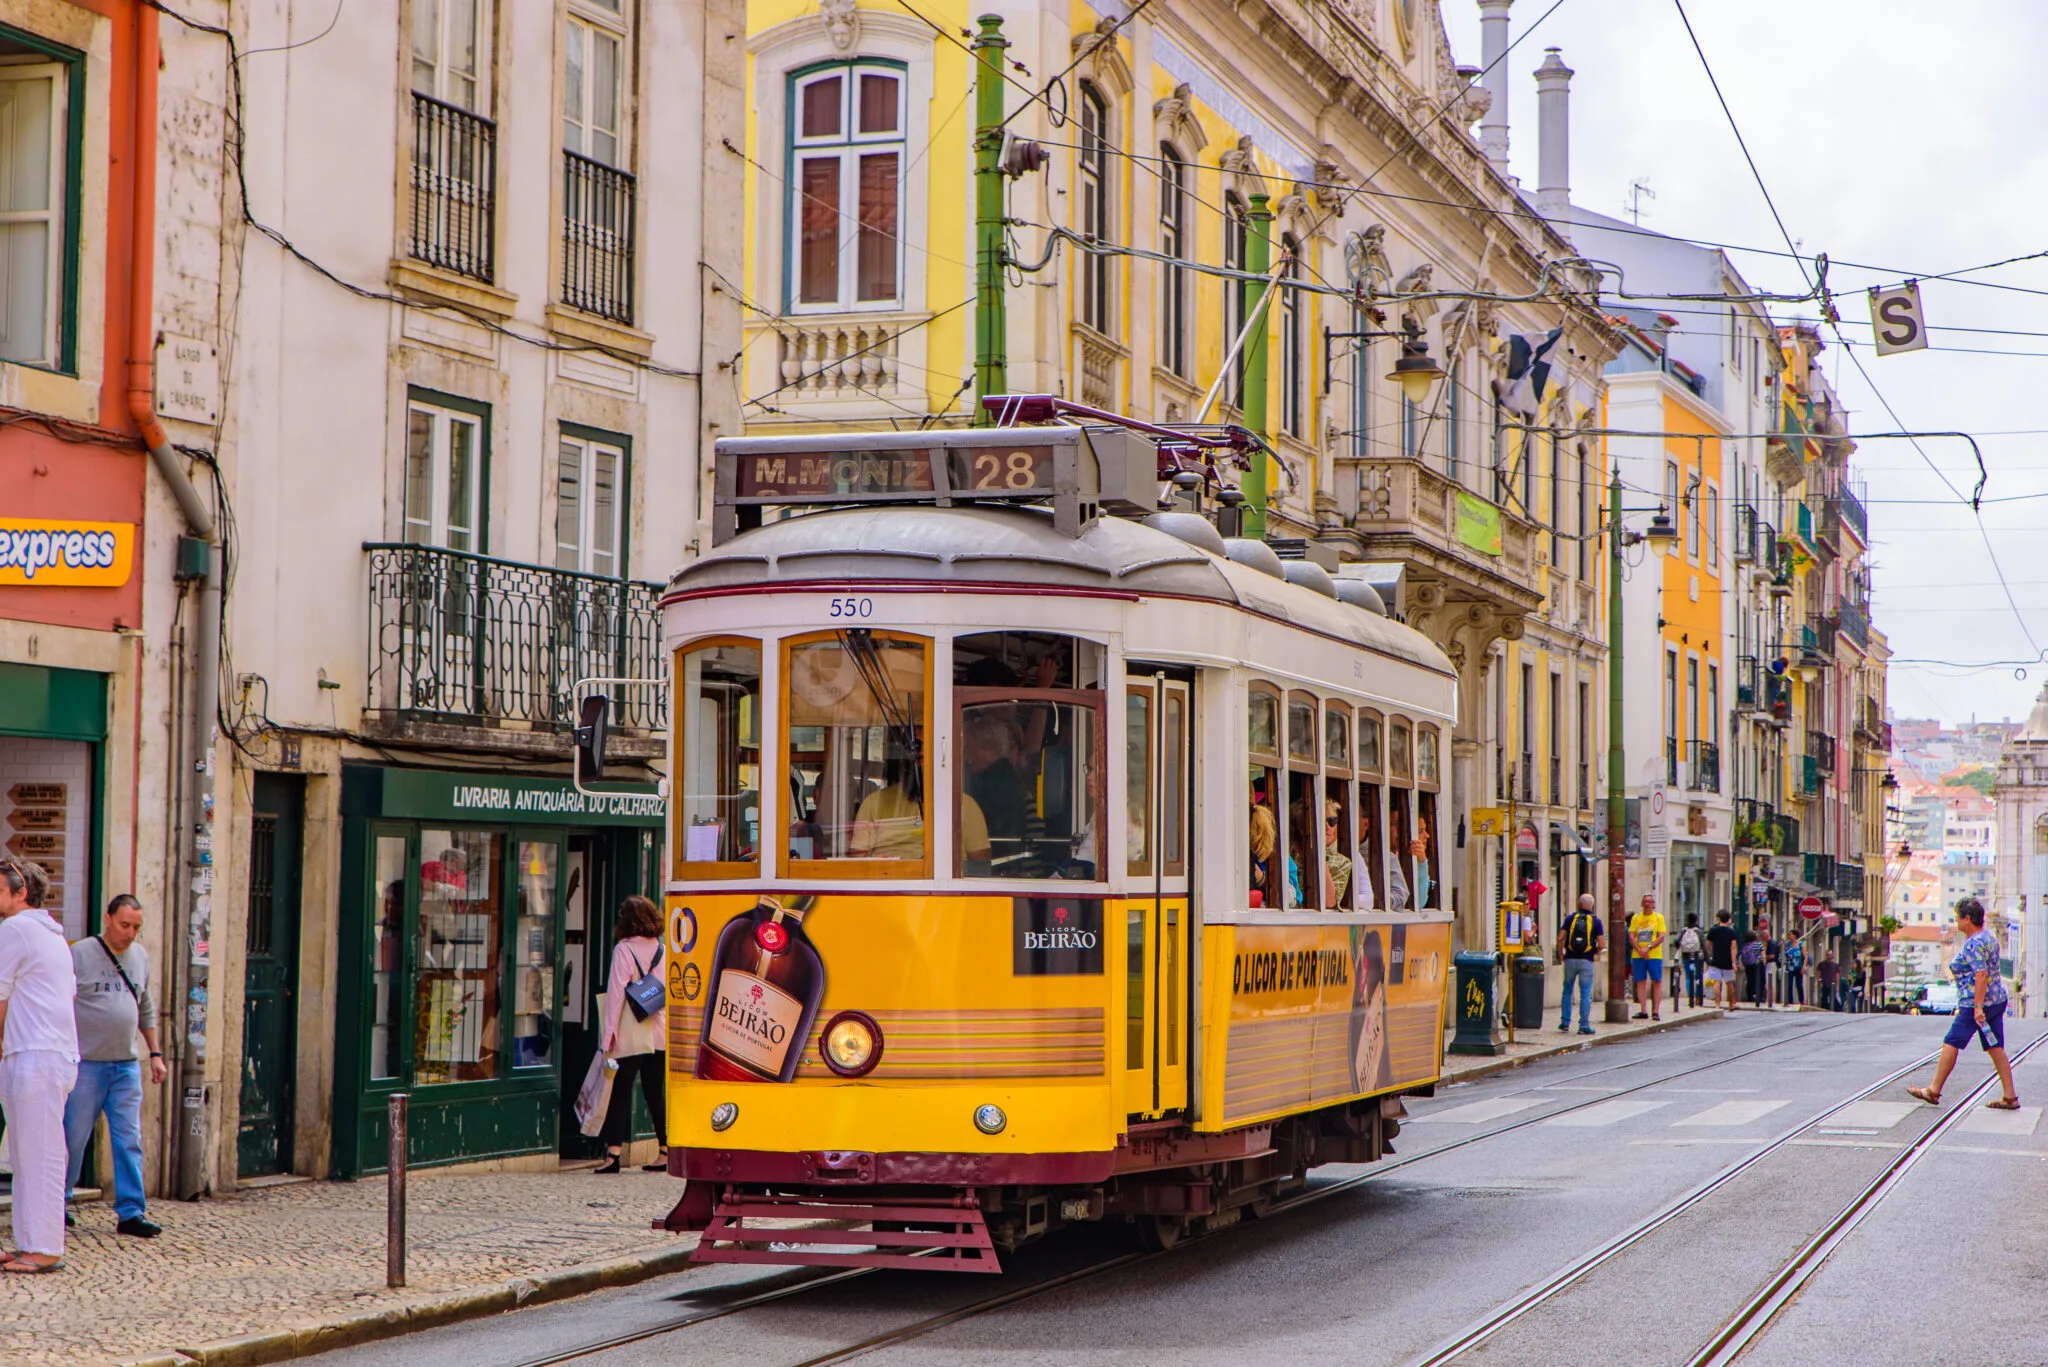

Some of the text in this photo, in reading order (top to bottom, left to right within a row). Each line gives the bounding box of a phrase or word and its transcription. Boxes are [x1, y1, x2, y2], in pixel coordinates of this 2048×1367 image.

[1881, 297, 1917, 346] S
[975, 451, 1036, 491] 28
[0, 529, 116, 579] express
[829, 597, 873, 618] 550
[453, 786, 665, 816] LIVRARIA ANTIQUÁRIA DO CALHARIZ
[643, 832, 653, 848] 14
[1023, 930, 1097, 949] BEIRÃO
[1233, 949, 1348, 995] O LICOR DE PORTUGAL
[718, 995, 786, 1044] BEIRÃO
[738, 999, 768, 1017] LICOR
[747, 1035, 772, 1052] PORTUGAL
